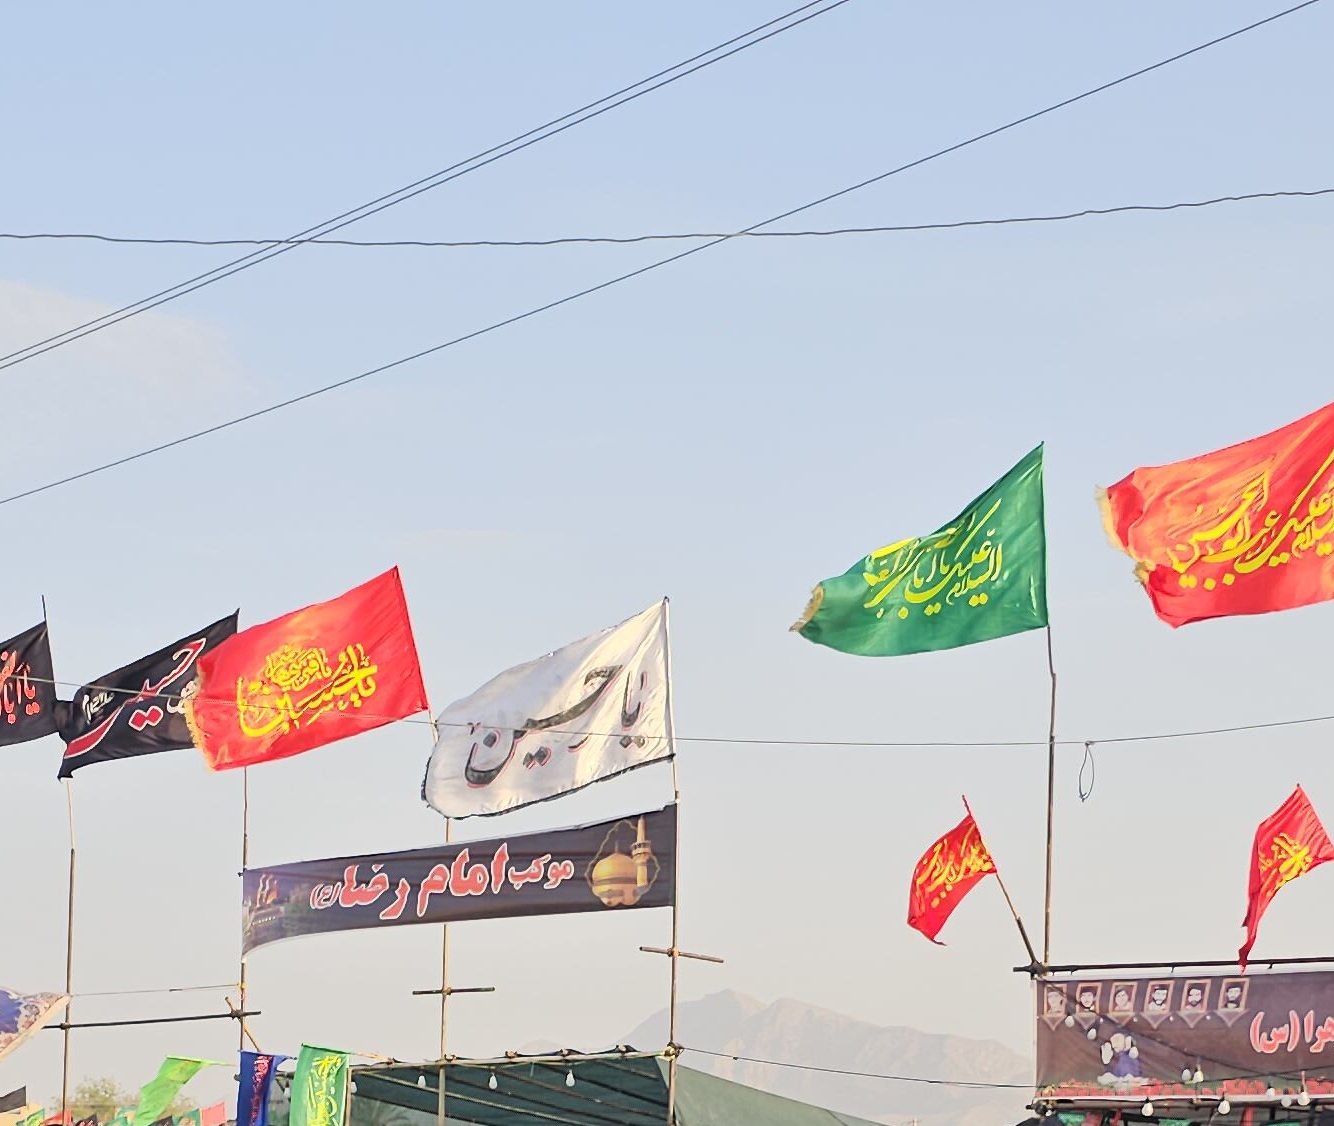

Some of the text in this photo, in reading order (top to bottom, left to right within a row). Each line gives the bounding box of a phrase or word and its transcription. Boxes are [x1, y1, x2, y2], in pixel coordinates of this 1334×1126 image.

[464, 664, 624, 789] حسین
[339, 863, 411, 920] رضا
[416, 842, 509, 918] امام
[508, 853, 574, 891] موکب
[1249, 1009, 1301, 1053] (س)
